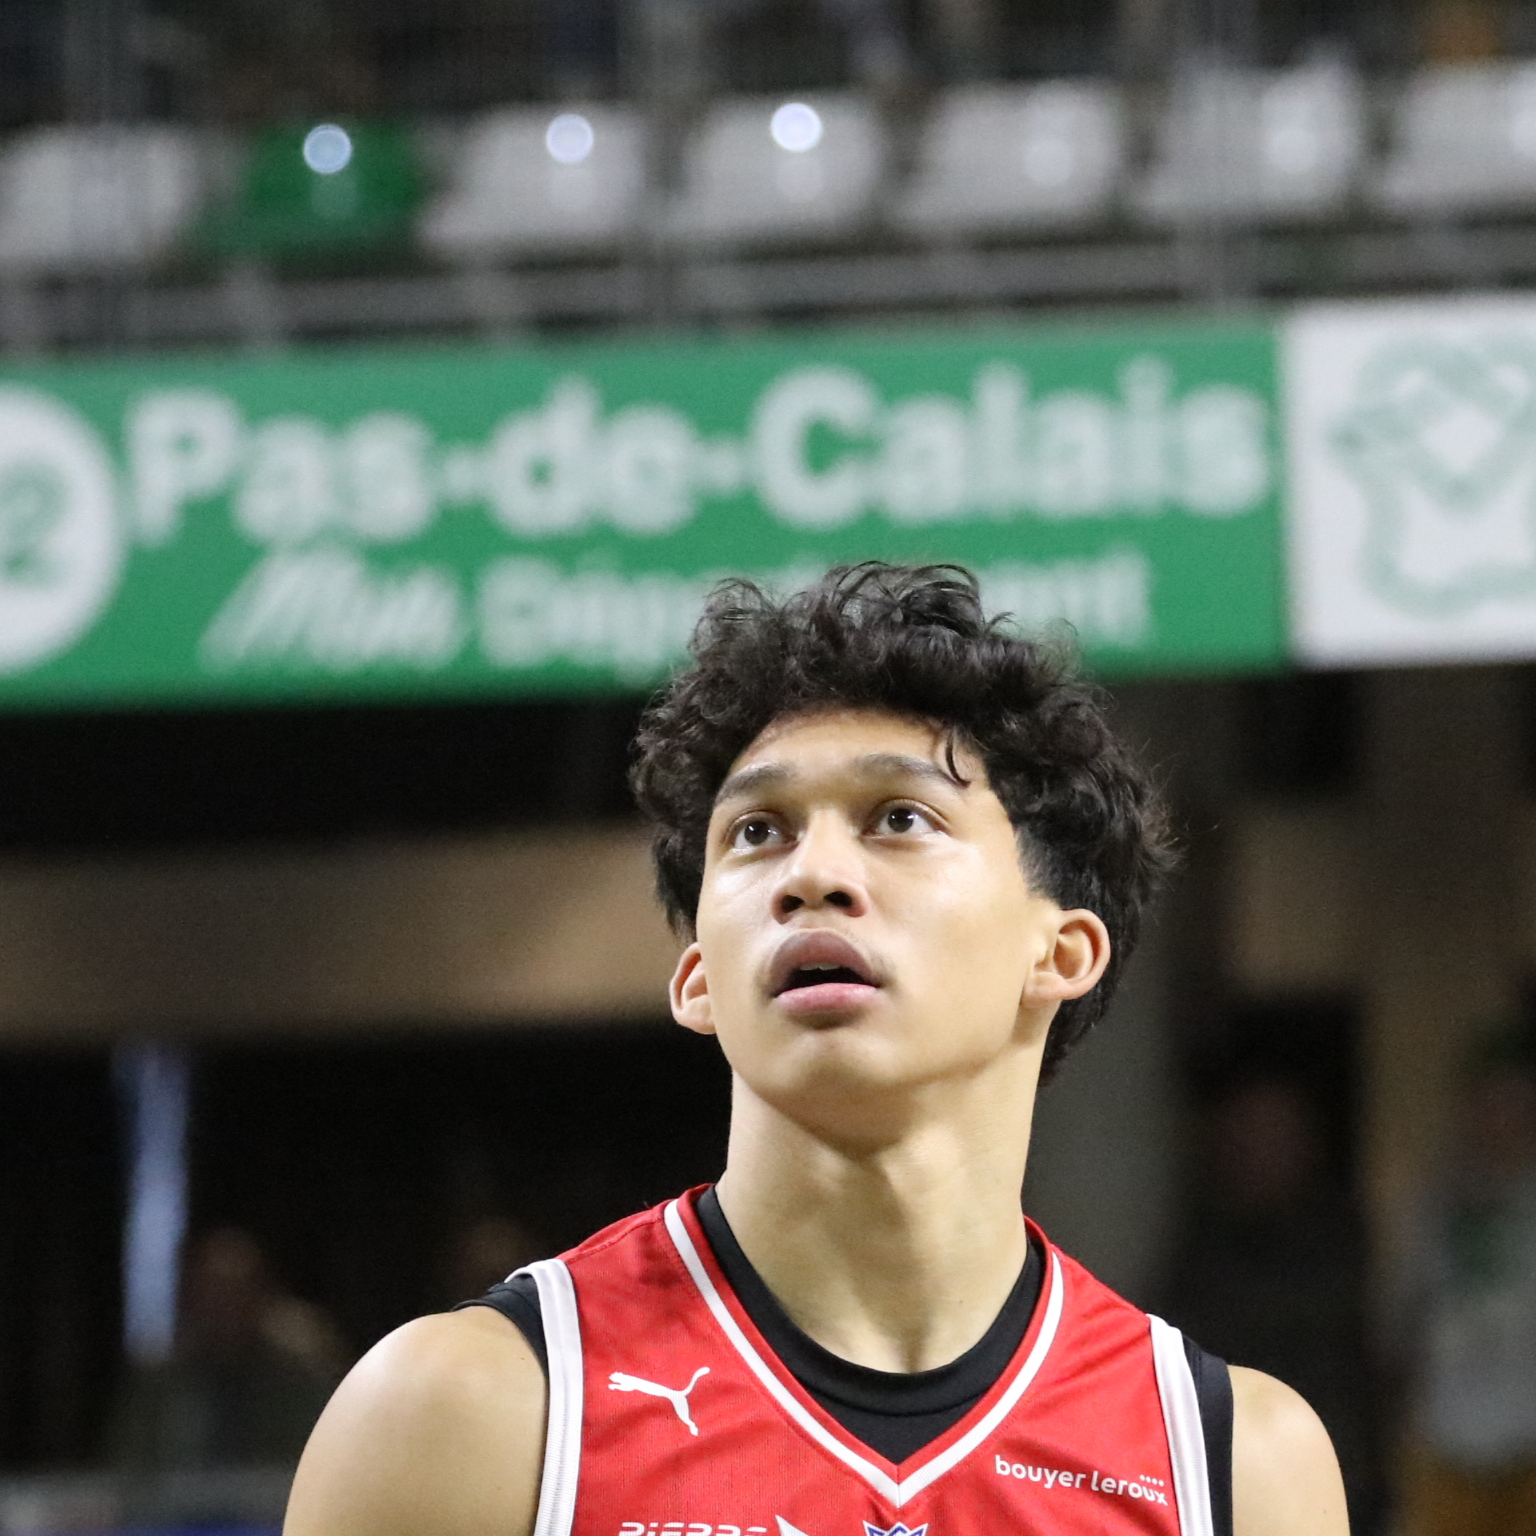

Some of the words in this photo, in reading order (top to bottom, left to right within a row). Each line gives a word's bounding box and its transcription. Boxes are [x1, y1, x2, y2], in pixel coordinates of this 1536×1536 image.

[122, 355, 1267, 547] Pas-de-Calais
[994, 1454, 1086, 1489] bouyer
[1091, 1470, 1169, 1507] leroux
